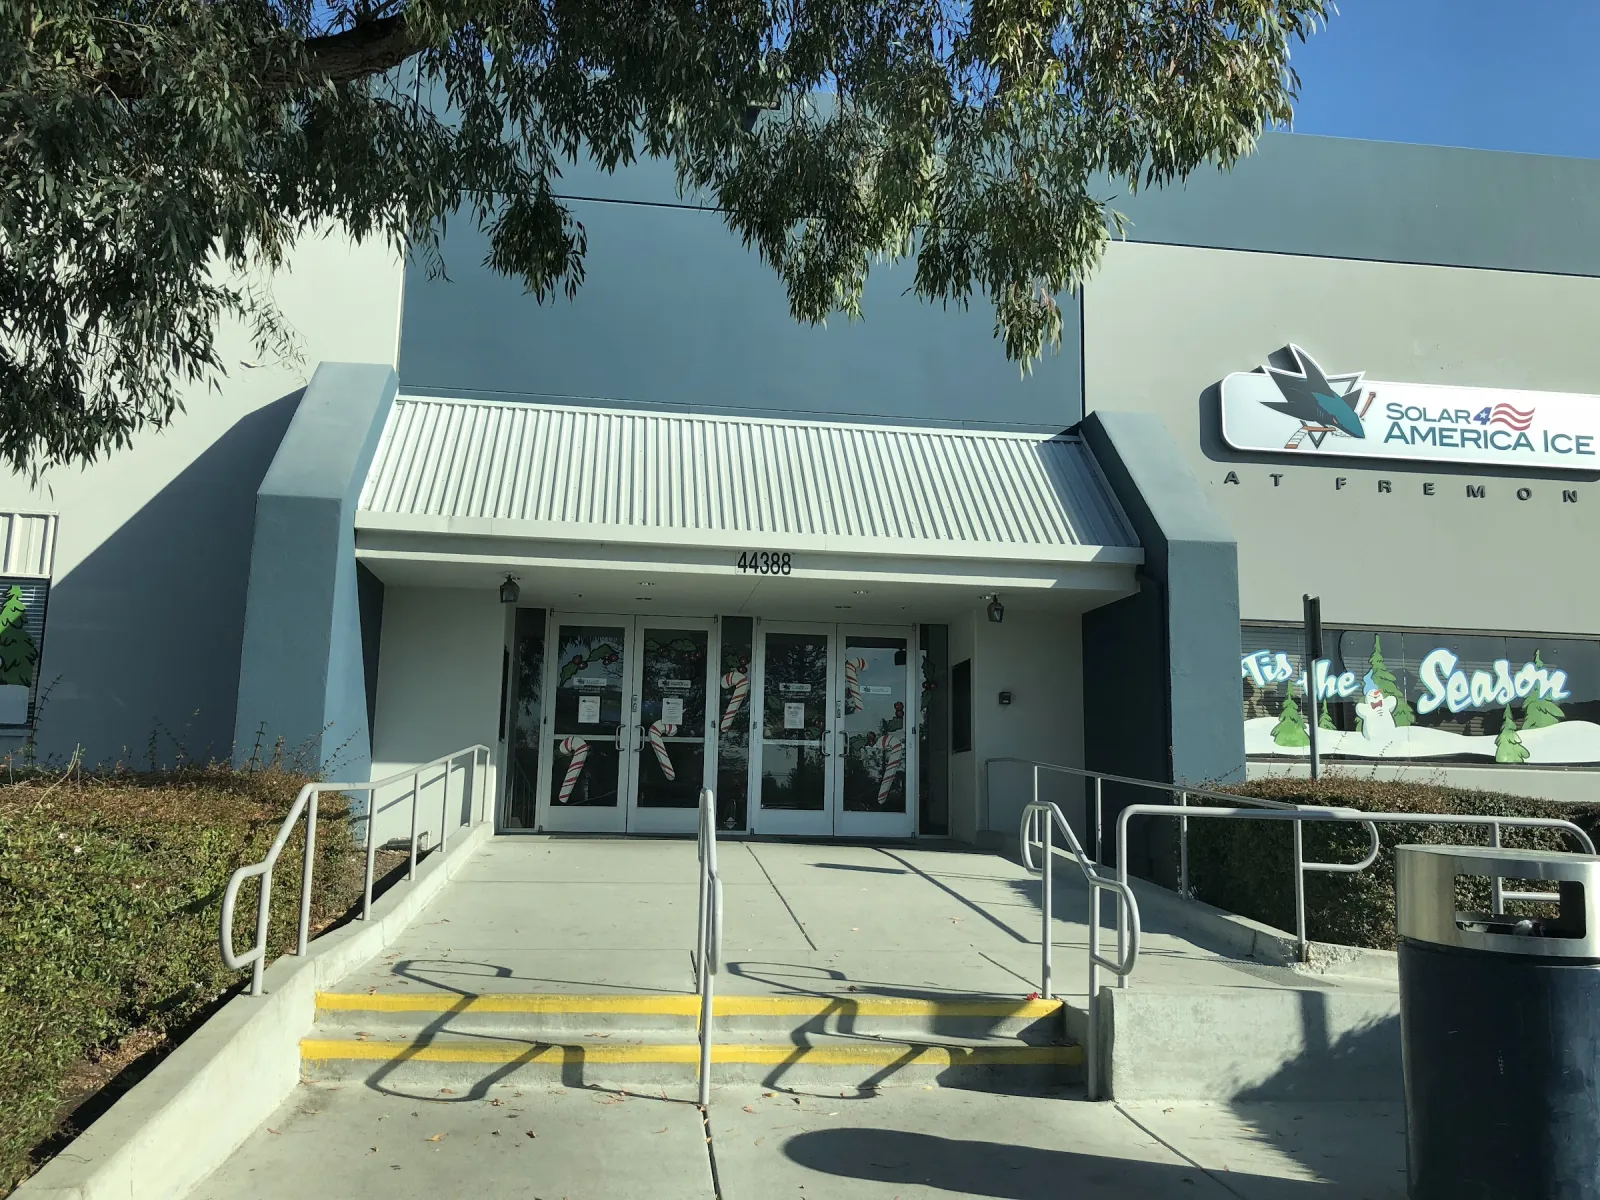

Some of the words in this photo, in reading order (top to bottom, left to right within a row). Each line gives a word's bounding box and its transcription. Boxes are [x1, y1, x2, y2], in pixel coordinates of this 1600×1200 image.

[1386, 402, 1471, 424] SOLAR
[1384, 421, 1535, 452] AMERICA
[1543, 430, 1596, 455] ICE
[1224, 471, 1283, 486] AT
[737, 551, 791, 575] 44388
[1417, 648, 1572, 714] Season
